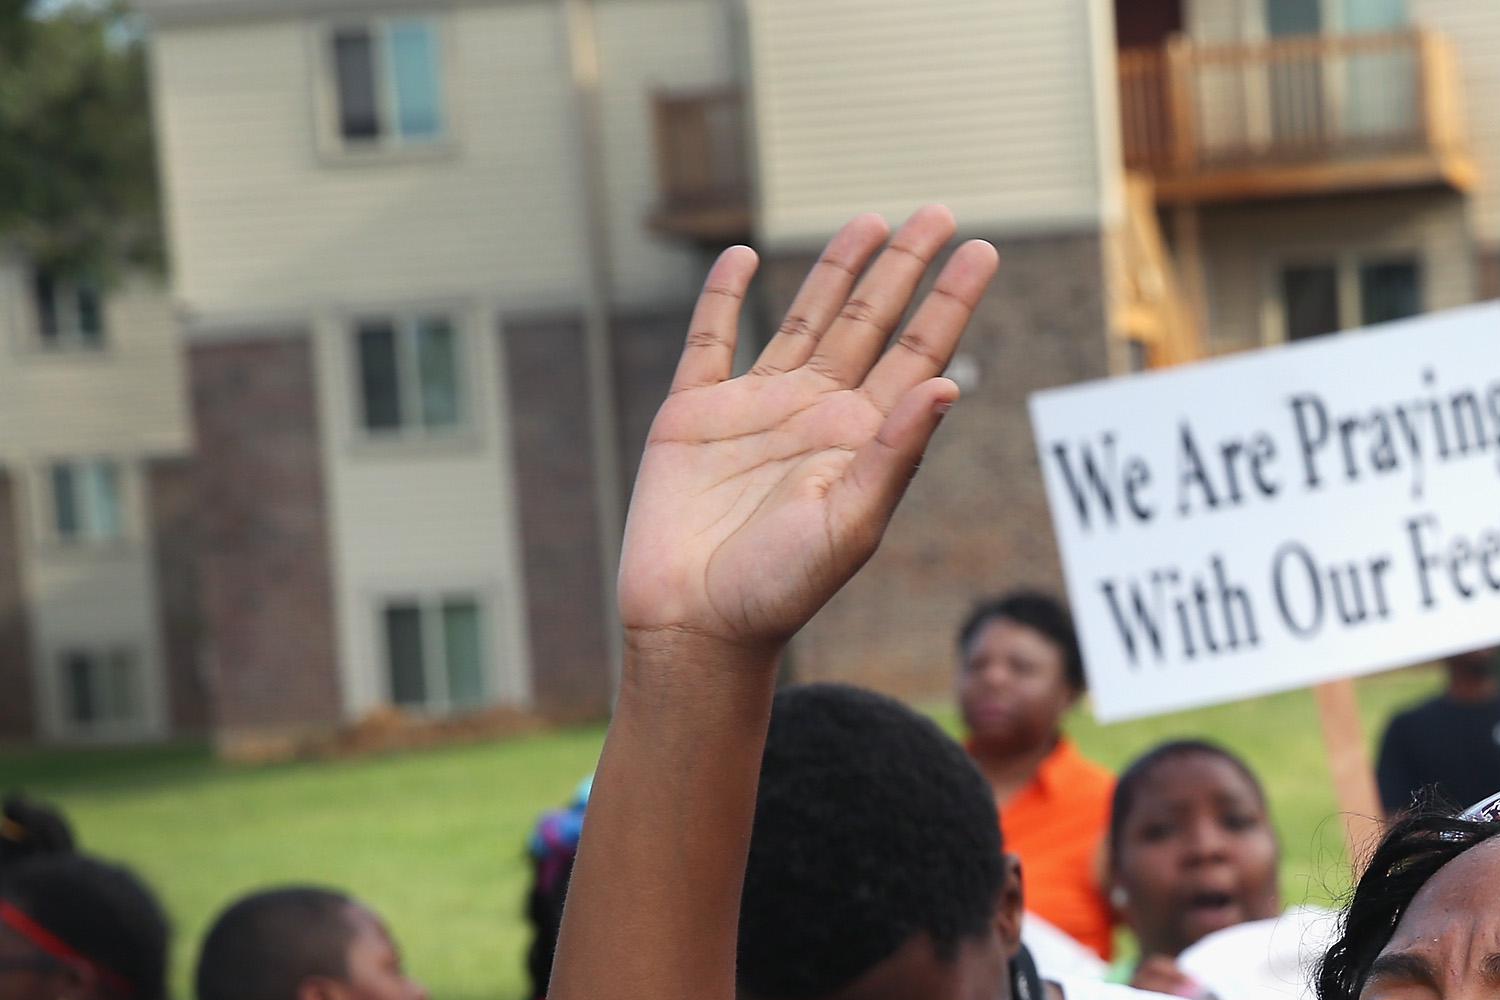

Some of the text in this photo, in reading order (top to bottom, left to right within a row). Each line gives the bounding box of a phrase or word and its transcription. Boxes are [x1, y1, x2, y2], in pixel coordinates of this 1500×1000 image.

[1049, 430, 1156, 534] We
[1176, 416, 1282, 517] Are
[1099, 554, 1261, 668] With
[1271, 541, 1393, 639] Our
